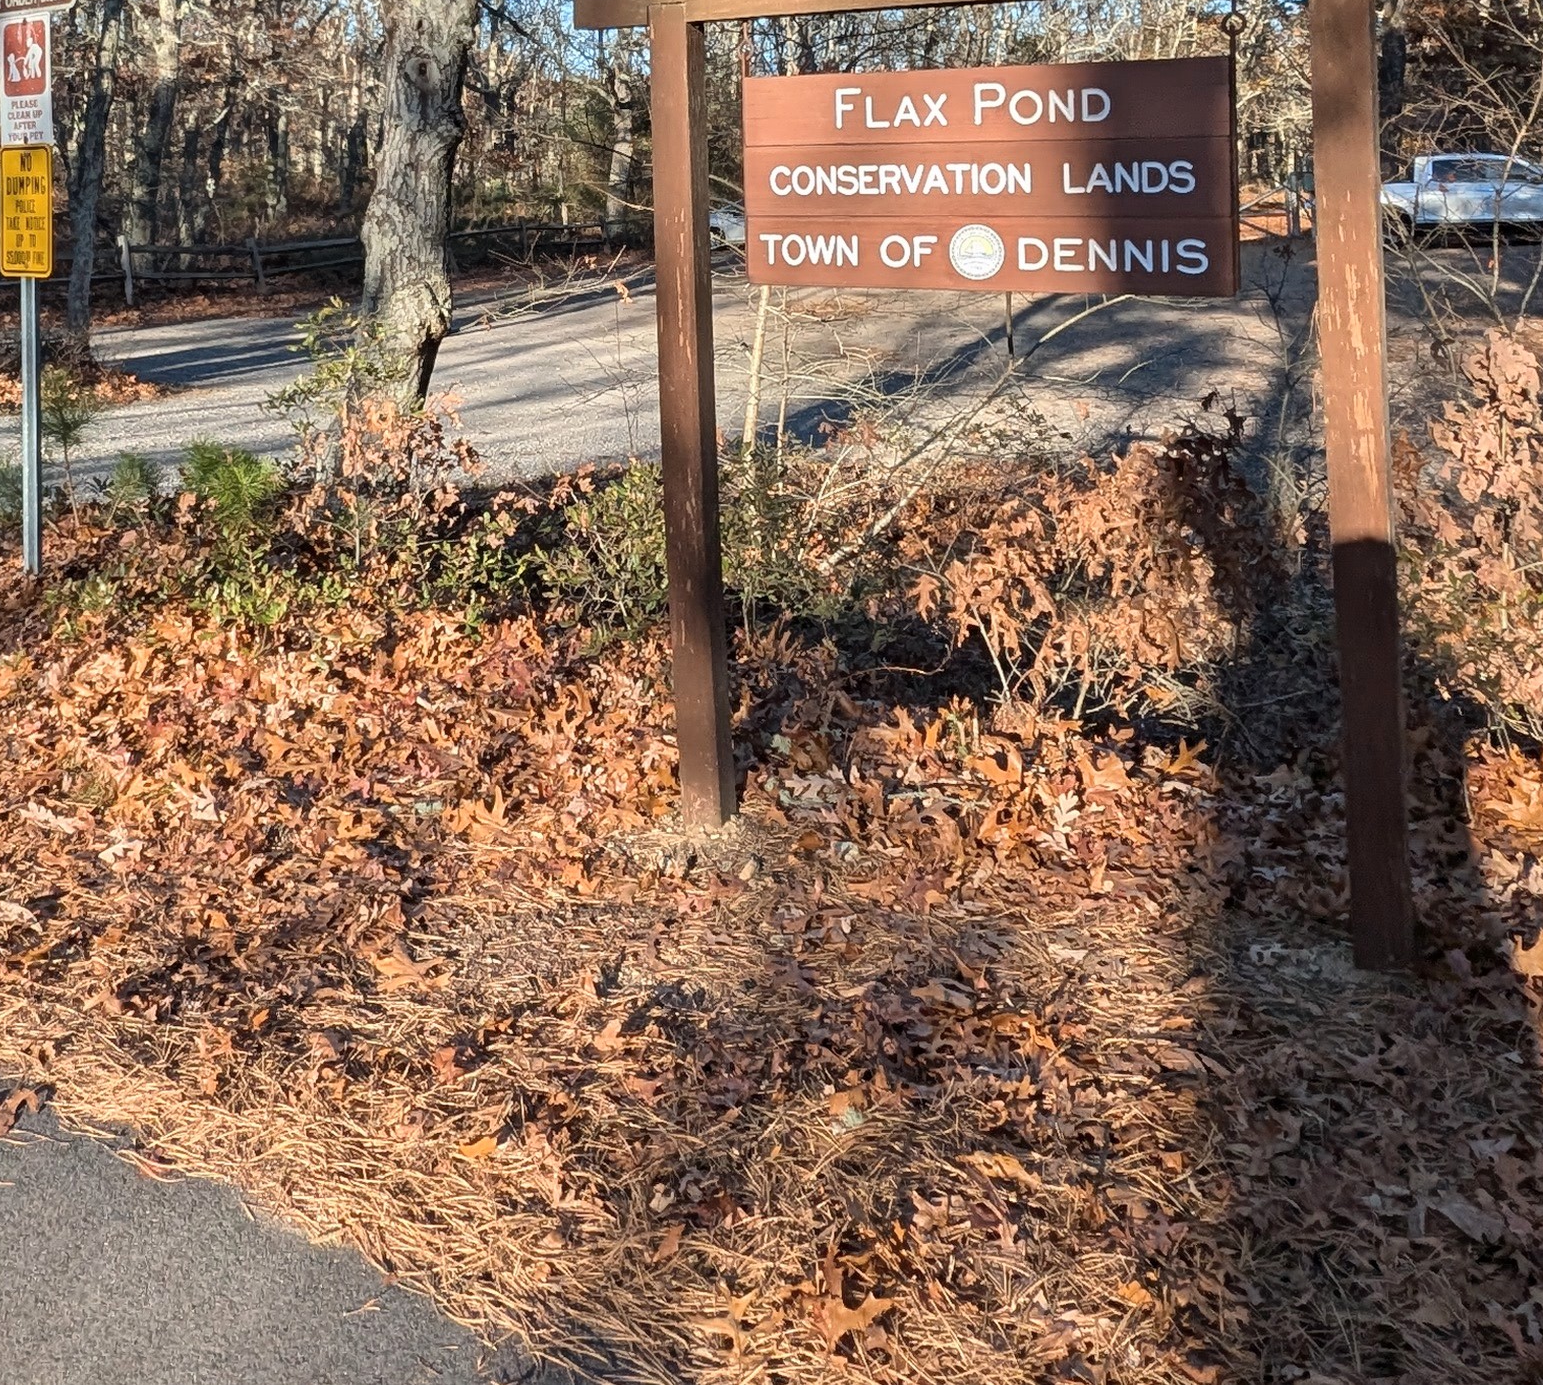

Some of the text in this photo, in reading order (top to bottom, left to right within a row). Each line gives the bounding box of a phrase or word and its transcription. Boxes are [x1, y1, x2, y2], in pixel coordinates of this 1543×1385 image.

[11, 99, 38, 110] PLEASE
[7, 110, 43, 120] CLEAN UP
[14, 121, 36, 130] AFTER
[29, 131, 43, 140] PET
[20, 152, 33, 172] NO
[769, 160, 1196, 196] CONSERVATION LANDS
[6, 176, 45, 196] DUMPING
[759, 233, 859, 267] TOWN
[879, 234, 938, 268] OF
[1017, 236, 1209, 275] DENNIS
